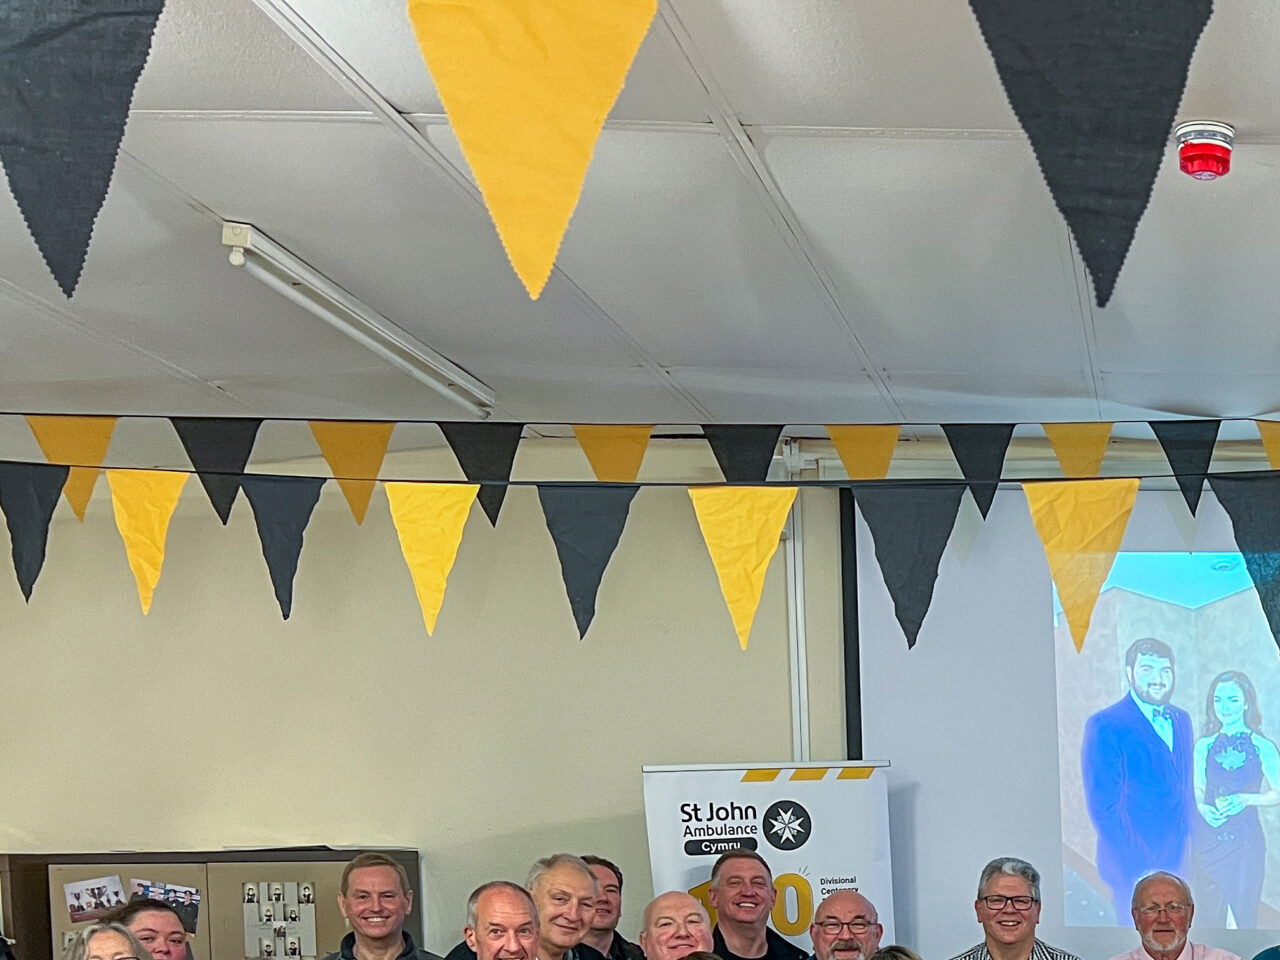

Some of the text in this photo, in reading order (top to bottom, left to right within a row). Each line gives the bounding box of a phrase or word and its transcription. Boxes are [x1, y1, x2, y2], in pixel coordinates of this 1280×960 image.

[680, 801, 757, 823] St John
[683, 823, 758, 838] Ambulance
[701, 841, 741, 854] Cymru
[820, 876, 857, 886] Divisional
